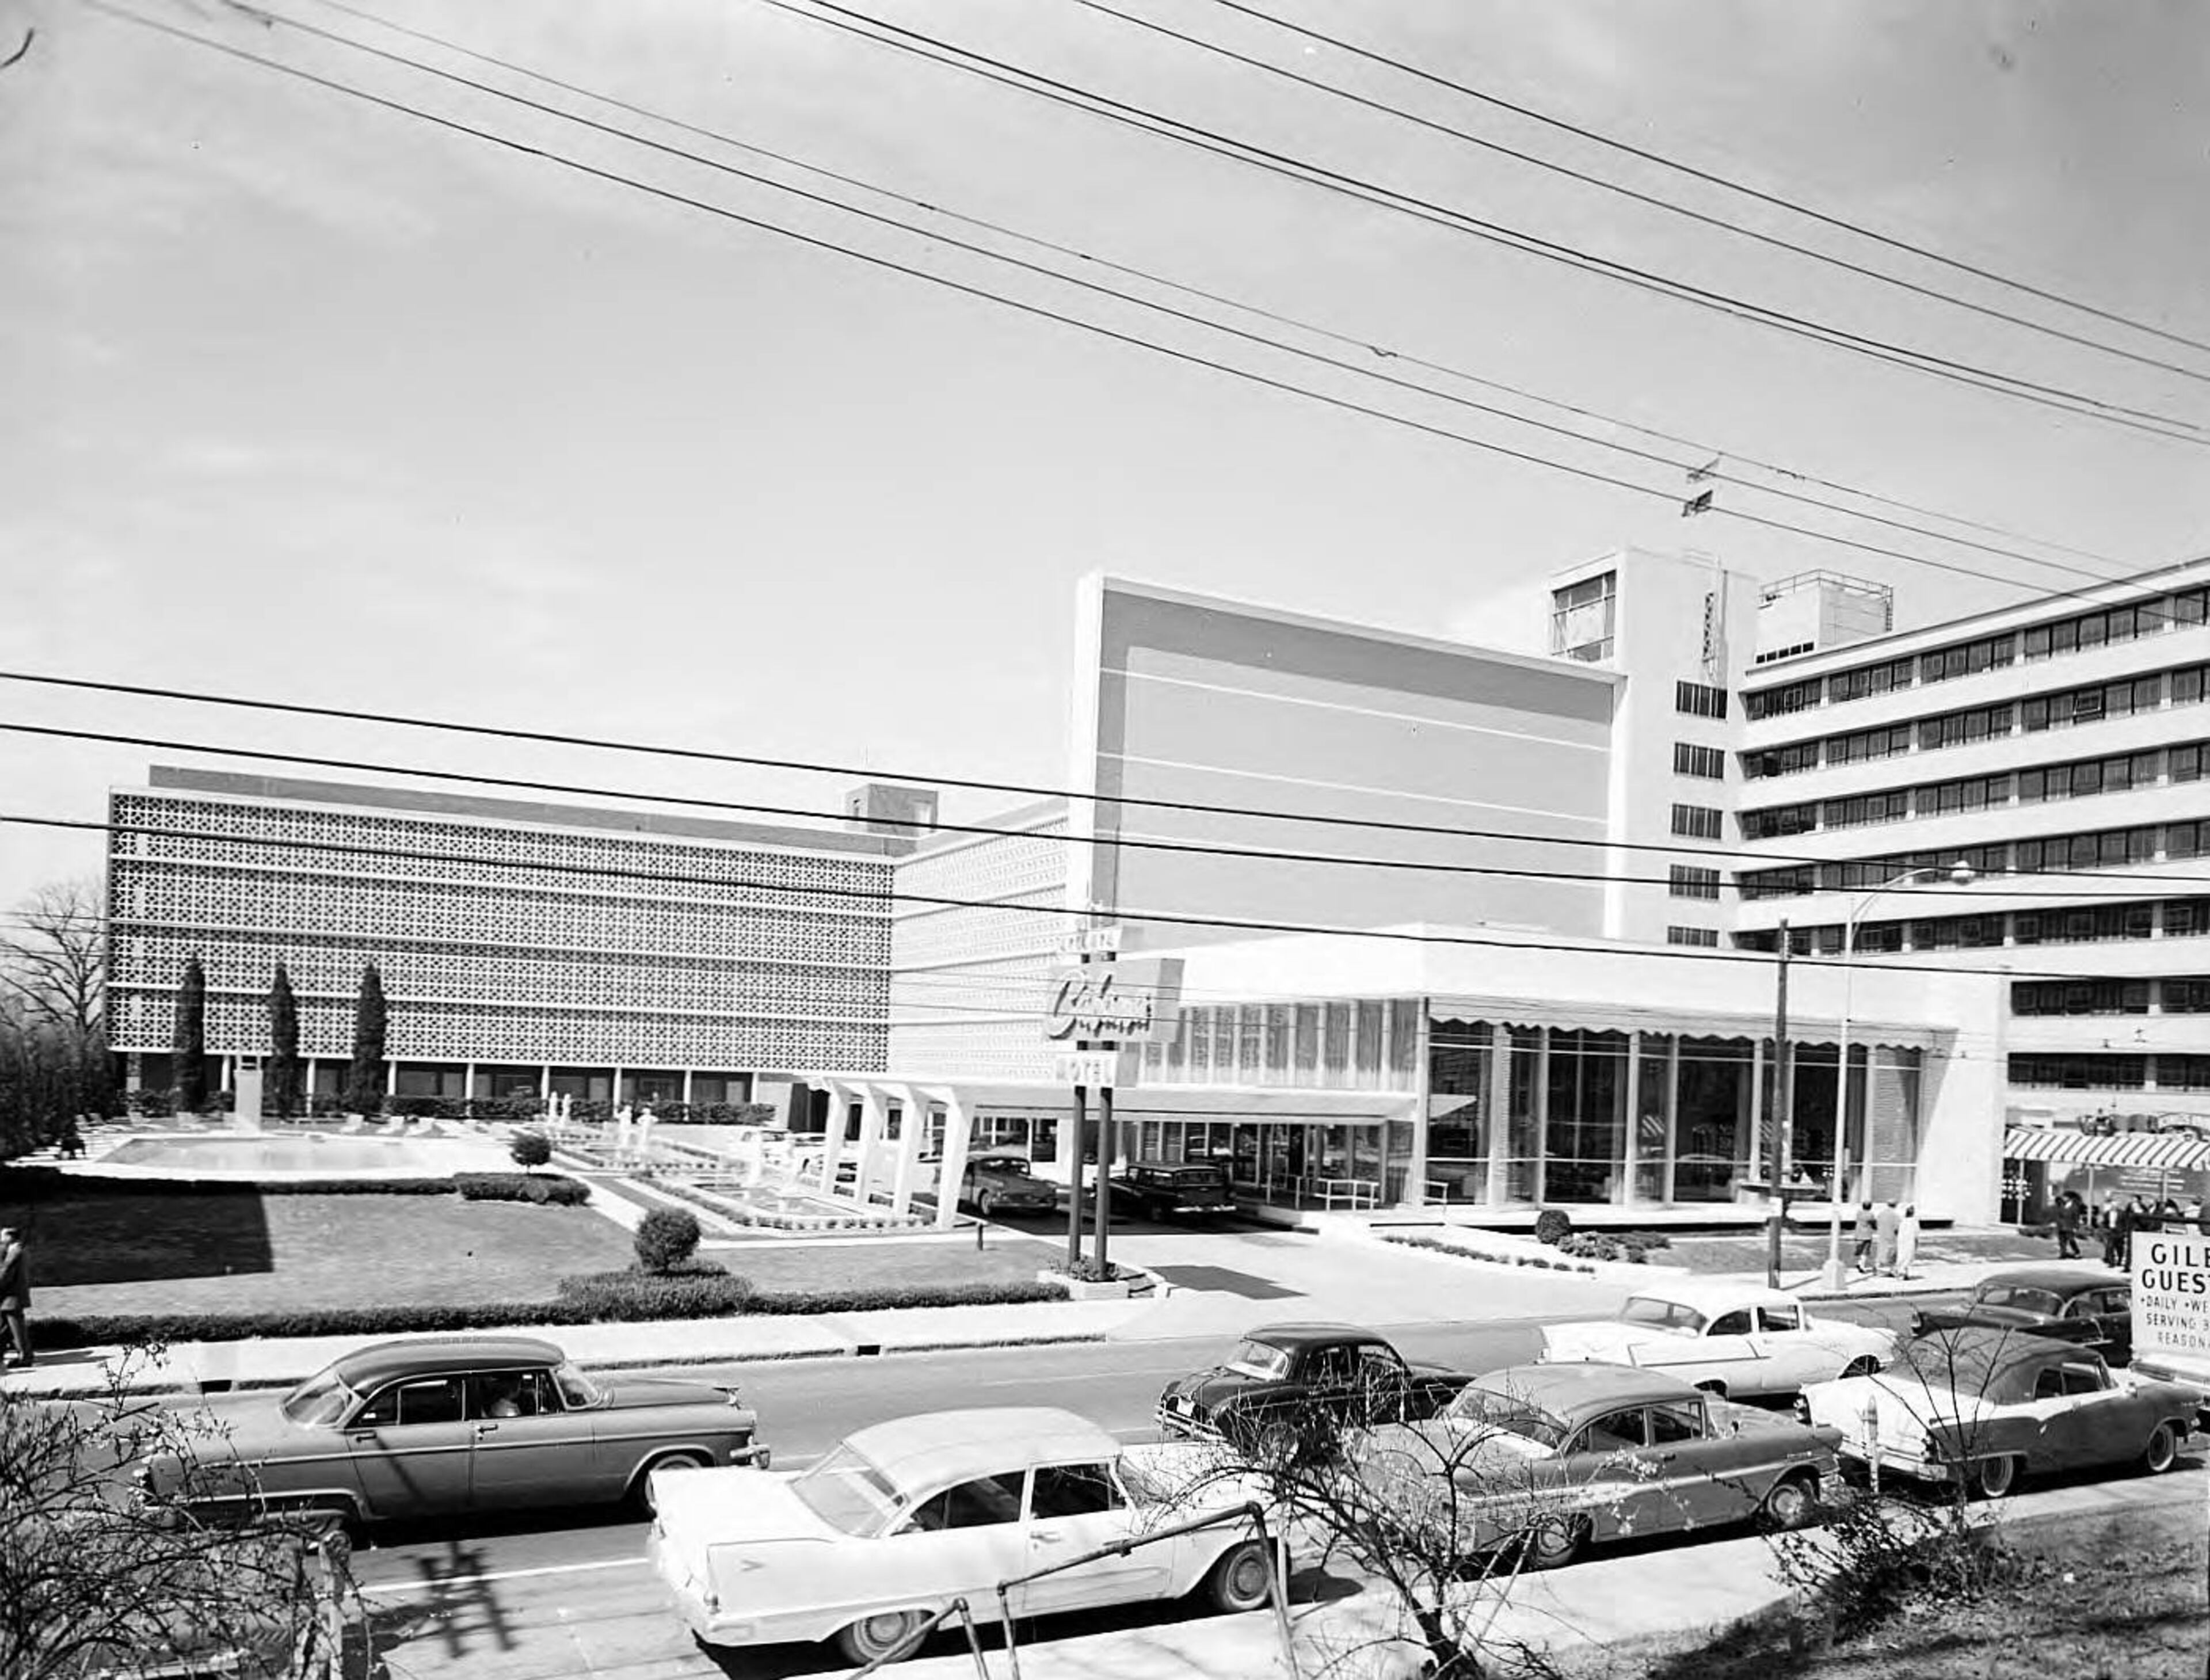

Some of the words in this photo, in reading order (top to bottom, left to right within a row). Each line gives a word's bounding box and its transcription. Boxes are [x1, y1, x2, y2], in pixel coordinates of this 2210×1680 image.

[2142, 1268, 2210, 1294] GUES
[2146, 1312, 2196, 1330] SERVING
[2158, 1331, 2210, 1348] REASON
